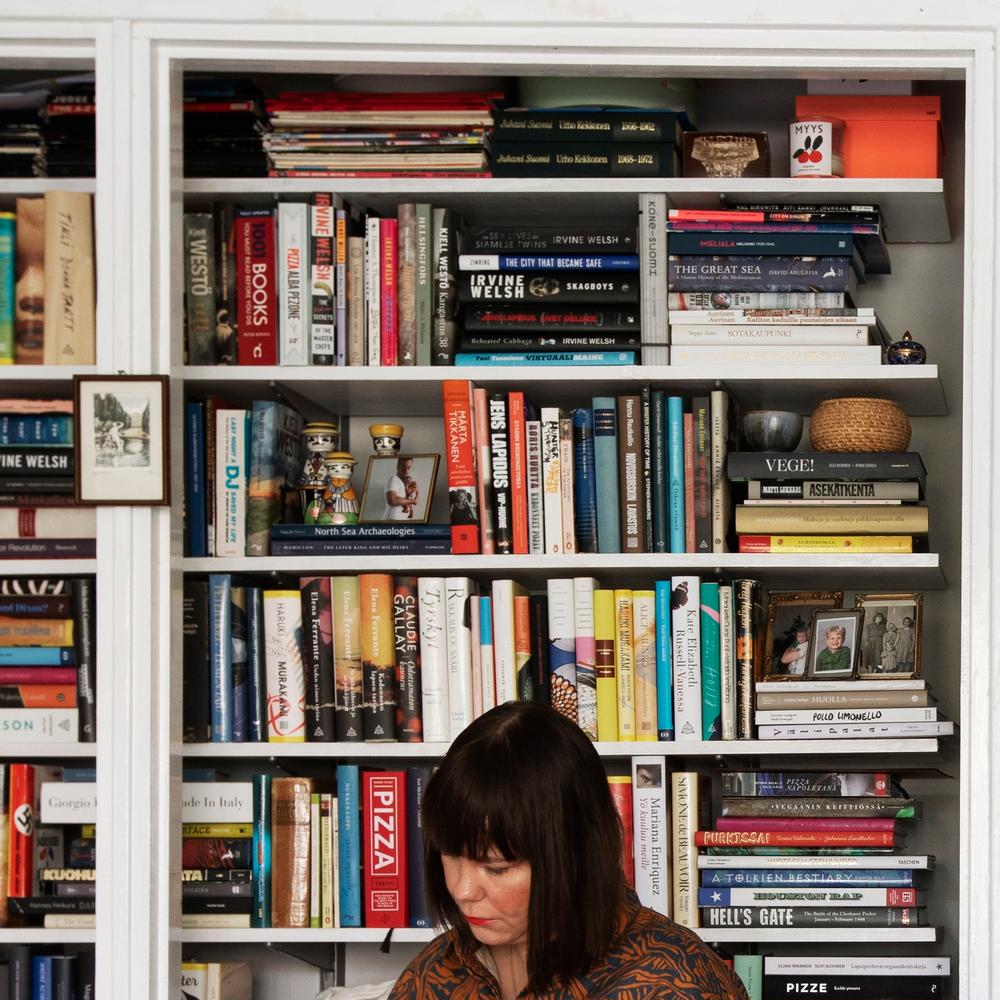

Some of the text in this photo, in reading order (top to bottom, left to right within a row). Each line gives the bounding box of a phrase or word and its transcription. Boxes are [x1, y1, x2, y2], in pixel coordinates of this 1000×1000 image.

[499, 120, 610, 130] Juhani Suomi Urho Kekkonen
[795, 125, 824, 135] MYYS
[497, 154, 609, 164] Juhani Suomi Urho Kekkonen
[316, 194, 331, 280] IRVINE WELSH
[418, 216, 426, 286] HELSINGFORS
[553, 236, 618, 244] IRVINE WELSH
[190, 240, 212, 296] WESTÖ
[252, 222, 268, 326] 1001 BOOKS
[506, 258, 602, 268] THE CITY THAT BECAME SAFE
[674, 265, 761, 274] THE GREAT SEA
[288, 248, 300, 320] PIZZA ALBA PEZONE
[438, 228, 450, 347] KJELL WESTÖ Kangastus 38
[470, 274, 525, 286] IRVINE
[470, 286, 525, 298] WELSH
[727, 330, 792, 338] SOTAKAUPUNKI
[698, 408, 706, 430] Mariana
[449, 410, 460, 463] TIKKANEN
[550, 421, 559, 459] HUNTER
[26, 454, 68, 468] WELSH
[490, 400, 508, 529] JENS LAPIDUS VIP-HUONE
[765, 459, 814, 472] VEGE!
[225, 466, 240, 490] DJ
[529, 424, 540, 551] BORIS HURTTA KADONNEET POJAT
[626, 453, 637, 501] NOVOSIBIRSKIN
[809, 483, 875, 497] ASEKÄTKENTÄ
[314, 527, 416, 538] North Sea Archaeologies
[627, 504, 637, 534] LAVASTUS
[311, 592, 319, 616] Elena
[619, 600, 629, 628] HARUKI
[640, 603, 649, 630] ALICE
[738, 603, 752, 629] Hayden
[343, 590, 353, 659] Elena Ferrante
[370, 588, 380, 657] Elena Ferrante
[394, 594, 406, 653] GALLAY
[405, 595, 417, 651] CLAUDIE
[420, 590, 442, 649] Tyrskyt
[448, 589, 465, 674] RAKKAUS SAARI
[312, 619, 320, 660] Ferrante
[620, 630, 630, 671] MURAKAMI
[640, 633, 649, 668] MUNRO
[687, 610, 697, 688] Kate Elizabeth
[277, 603, 288, 717] HARUKI MURAKAMI
[676, 629, 686, 712] Russell Vanessa
[399, 660, 408, 691] kauneus
[406, 660, 416, 711] Odottamaton
[378, 673, 386, 712] Kadonneen
[811, 695, 847, 703] HUOLLA
[813, 710, 882, 722] POLLO LIMONELLO
[787, 778, 810, 786] PIZZA
[48, 797, 91, 810] Giorgio
[205, 797, 244, 810] In Italy
[826, 802, 881, 810] KEITTIÖSSÄ
[374, 791, 394, 870] PIZZA
[640, 798, 649, 870] Yö kuuluu meille
[677, 777, 689, 892] SIMONE de BEAUVOIR
[650, 798, 661, 896] Mariana Enriquez
[712, 873, 853, 883] A TOLKIEN BESTIARY
[754, 892, 863, 901] HOUSTON RAP
[710, 908, 793, 925] HELL'S GATE
[786, 983, 828, 993] PIZZE
